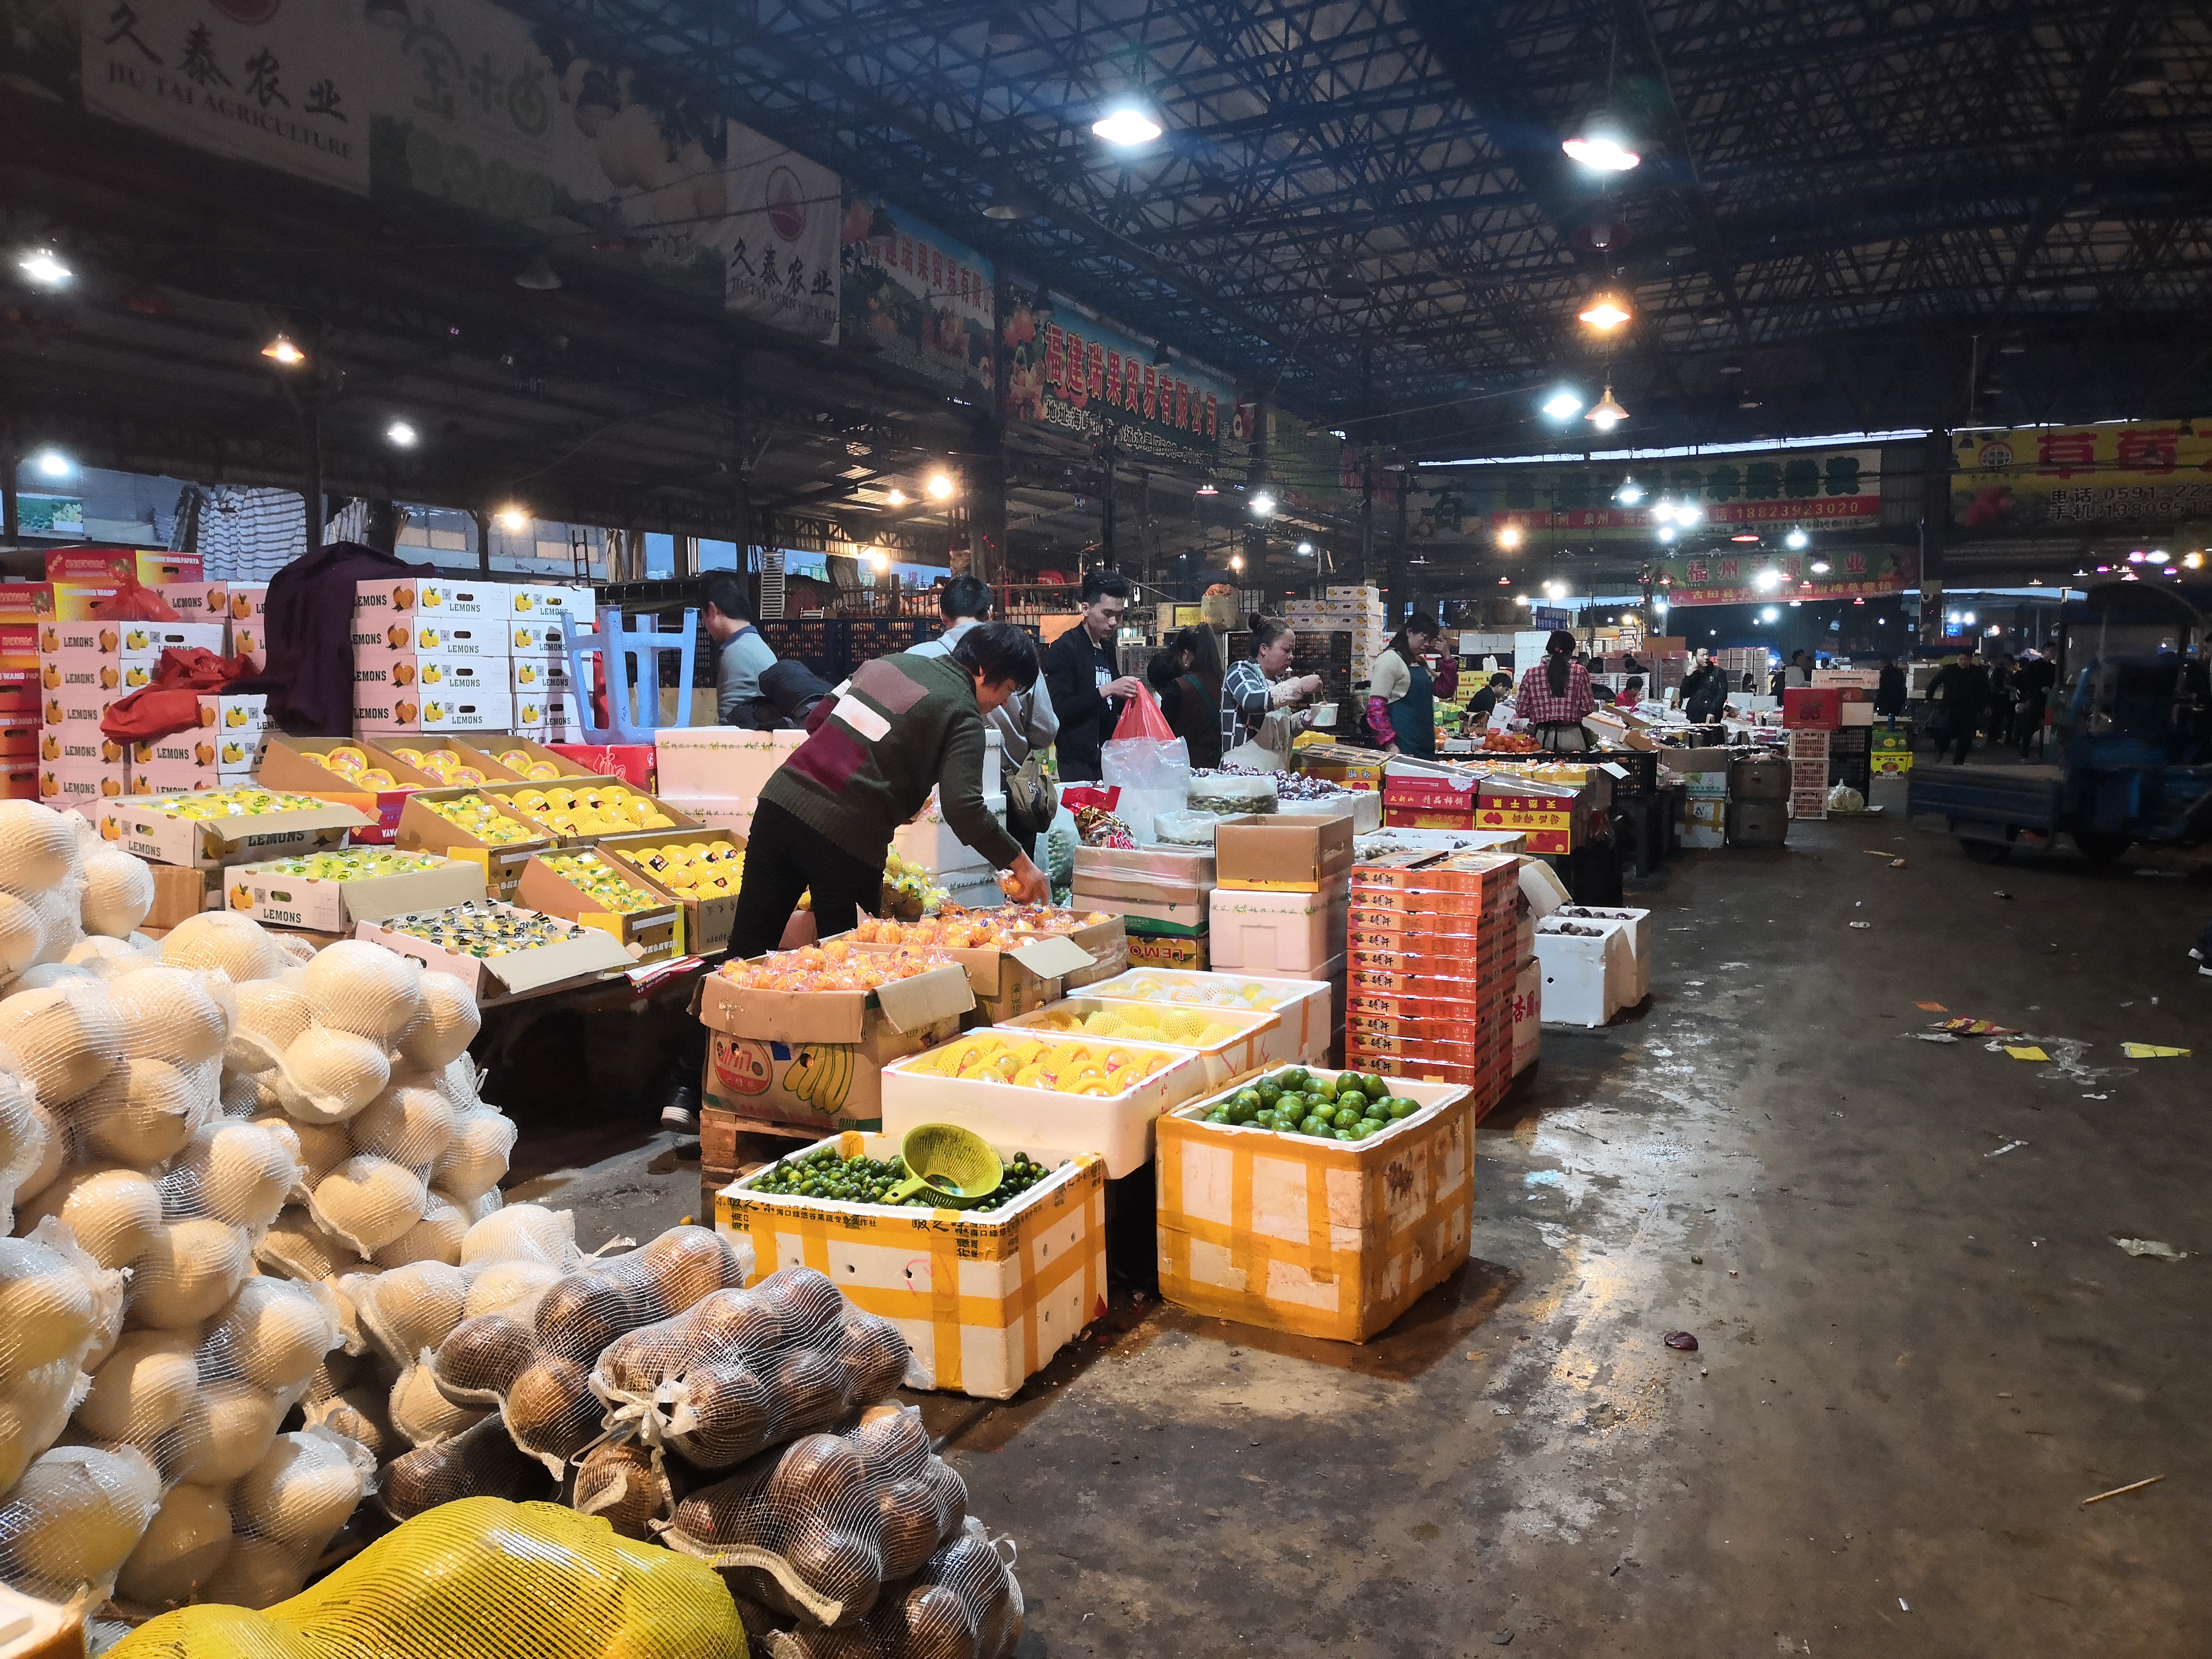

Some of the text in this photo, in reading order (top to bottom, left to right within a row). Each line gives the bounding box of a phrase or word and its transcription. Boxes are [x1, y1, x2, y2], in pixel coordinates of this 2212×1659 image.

[103, 2, 349, 123] 久泰农业
[153, 74, 195, 106] TAI
[204, 94, 354, 160] AGRICULTURE
[731, 237, 835, 298] 久泰农业
[1045, 321, 1218, 441] 福建瑞果贸易有限公司
[172, 597, 206, 609] LEMONS
[449, 603, 481, 613] LEMONS
[63, 637, 94, 648] LEMONS
[352, 634, 382, 645] EMONS
[447, 645, 479, 653] LEMONS
[65, 673, 95, 684] LEMONS
[449, 679, 481, 687] LEMONS
[542, 678, 569, 686] LEMONS
[67, 709, 97, 720] LEMONS
[452, 716, 483, 724] LEMONS
[545, 717, 571, 726] LEMONS
[65, 745, 96, 757] LEMONS
[157, 747, 189, 760] LEMONS
[63, 782, 96, 794] LEMONS
[1492, 798, 1556, 809] 天然干果
[128, 840, 161, 857] LEMONS
[263, 908, 302, 924] LEMONS
